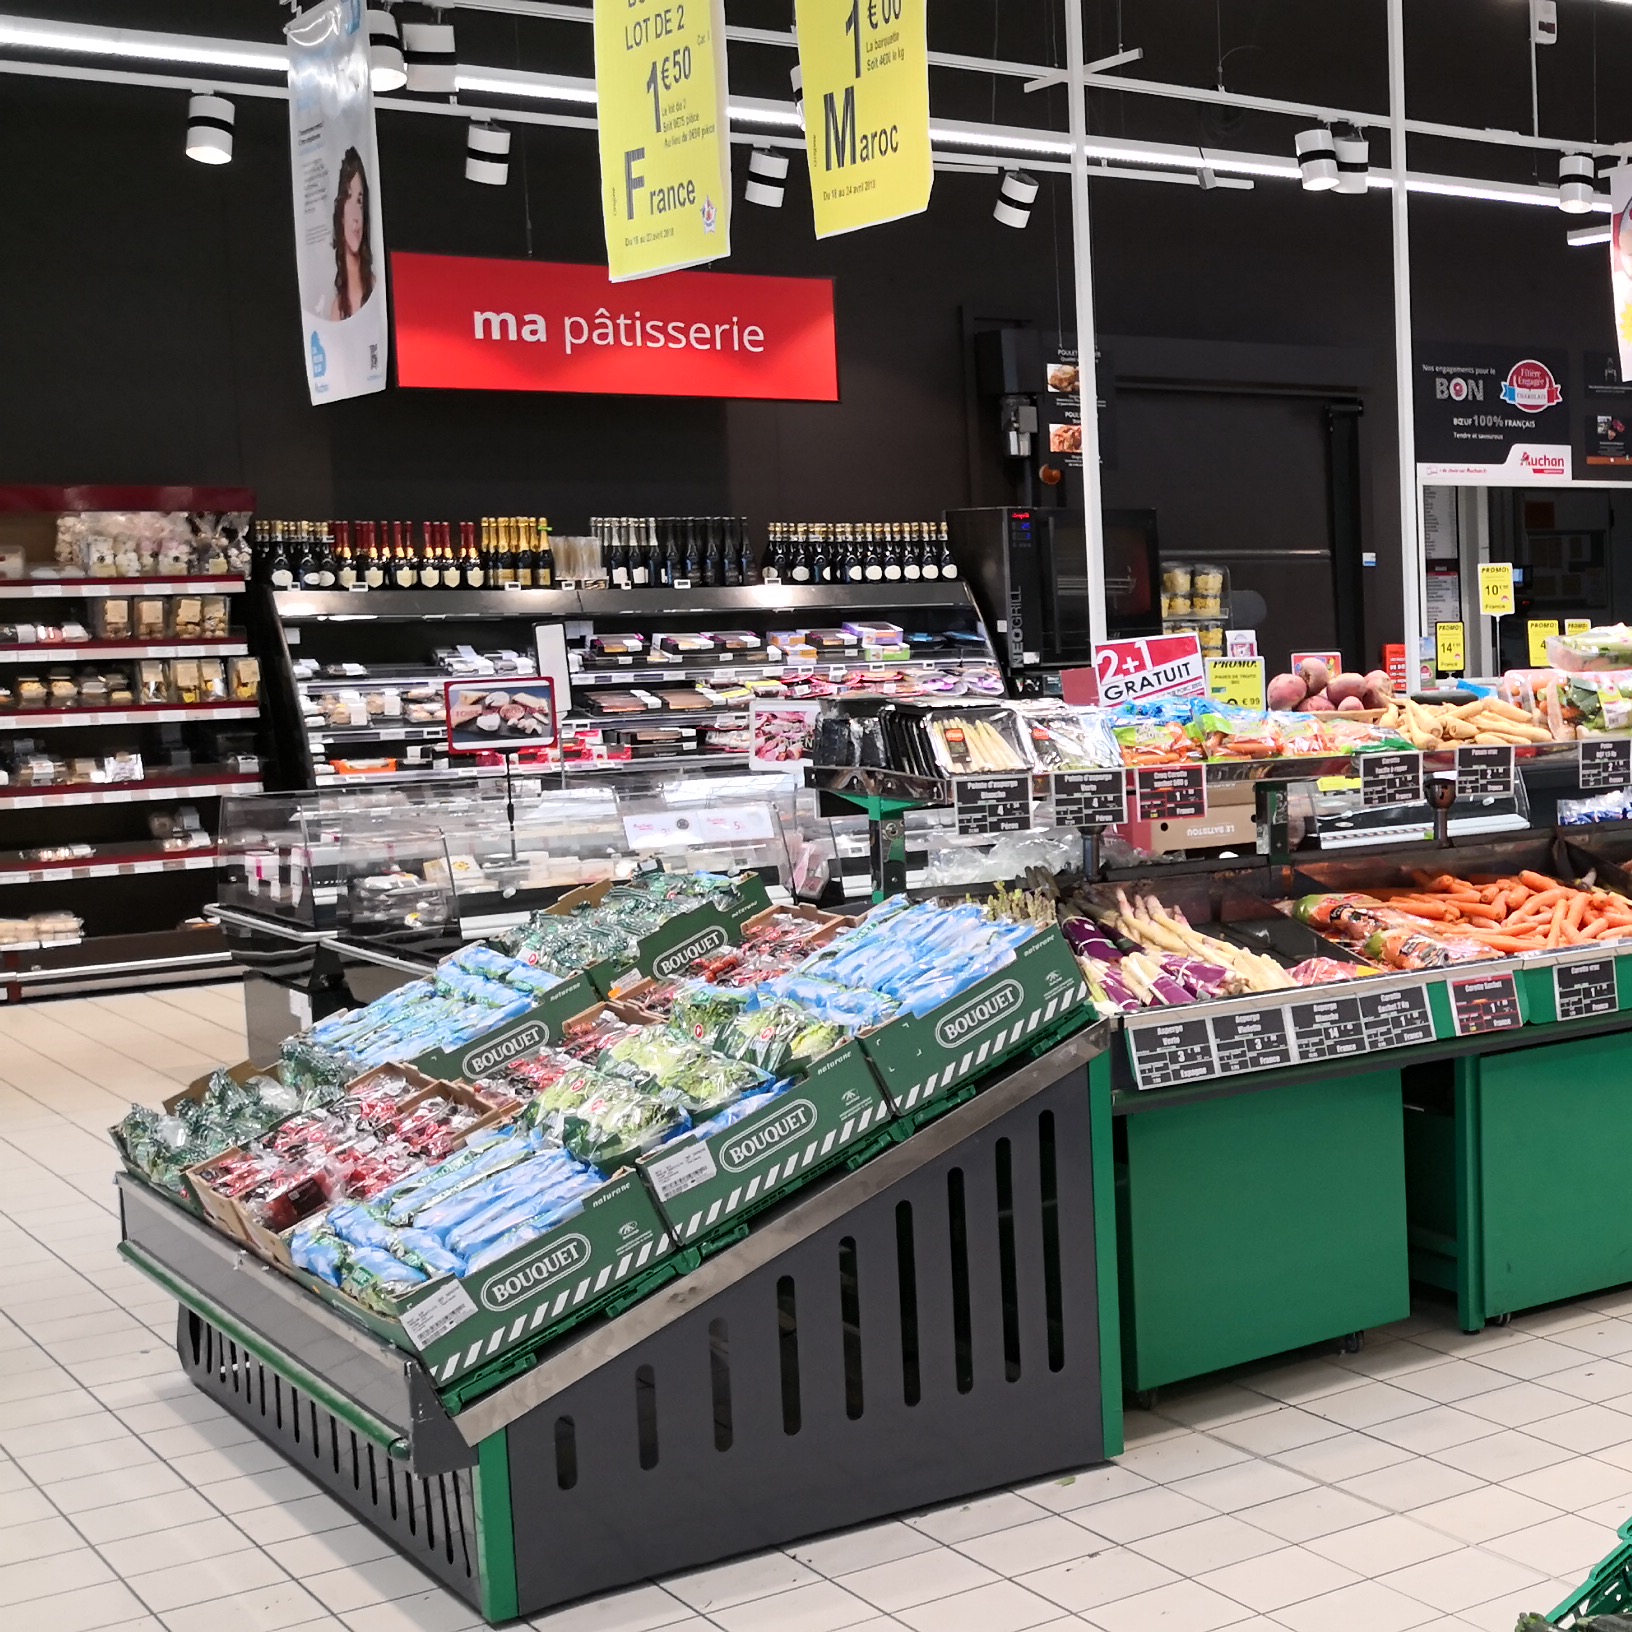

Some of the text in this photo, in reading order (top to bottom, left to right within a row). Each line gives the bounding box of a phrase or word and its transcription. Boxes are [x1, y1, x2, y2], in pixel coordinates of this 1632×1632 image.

[625, 4, 685, 50] LOT DE 2
[866, 42, 873, 53] La
[867, 59, 878, 71] Soit
[824, 85, 899, 172] Maroc
[624, 146, 697, 221] France
[823, 190, 831, 201] Du
[473, 307, 765, 355] ma pâtisserie
[1422, 364, 1434, 373] Nos
[1435, 365, 1475, 375] engagements
[1475, 367, 1490, 376] pour
[1435, 377, 1484, 401] BON
[1473, 414, 1504, 428] 100%
[1504, 419, 1536, 430] FRANÇAIS
[1520, 452, 1565, 468] Auchan
[1481, 566, 1510, 574] PROMO!
[1485, 584, 1500, 596] 10
[1010, 585, 1024, 668] NEOGRILL
[1438, 624, 1462, 632] PROMO!
[1440, 642, 1453, 654] 14
[1096, 639, 1154, 686] 2+1
[1104, 661, 1191, 701] GRATUIT
[660, 931, 721, 975] BOUQUET
[943, 986, 1016, 1041] BOUQUET
[1254, 1038, 1262, 1050] 3
[1328, 1027, 1340, 1039] 14
[470, 1025, 541, 1073] BOUQUET
[1177, 1051, 1186, 1063] 3
[728, 1107, 809, 1165] BOUQUET
[592, 1182, 632, 1208] naturane
[491, 1241, 582, 1303] BOUQUET
